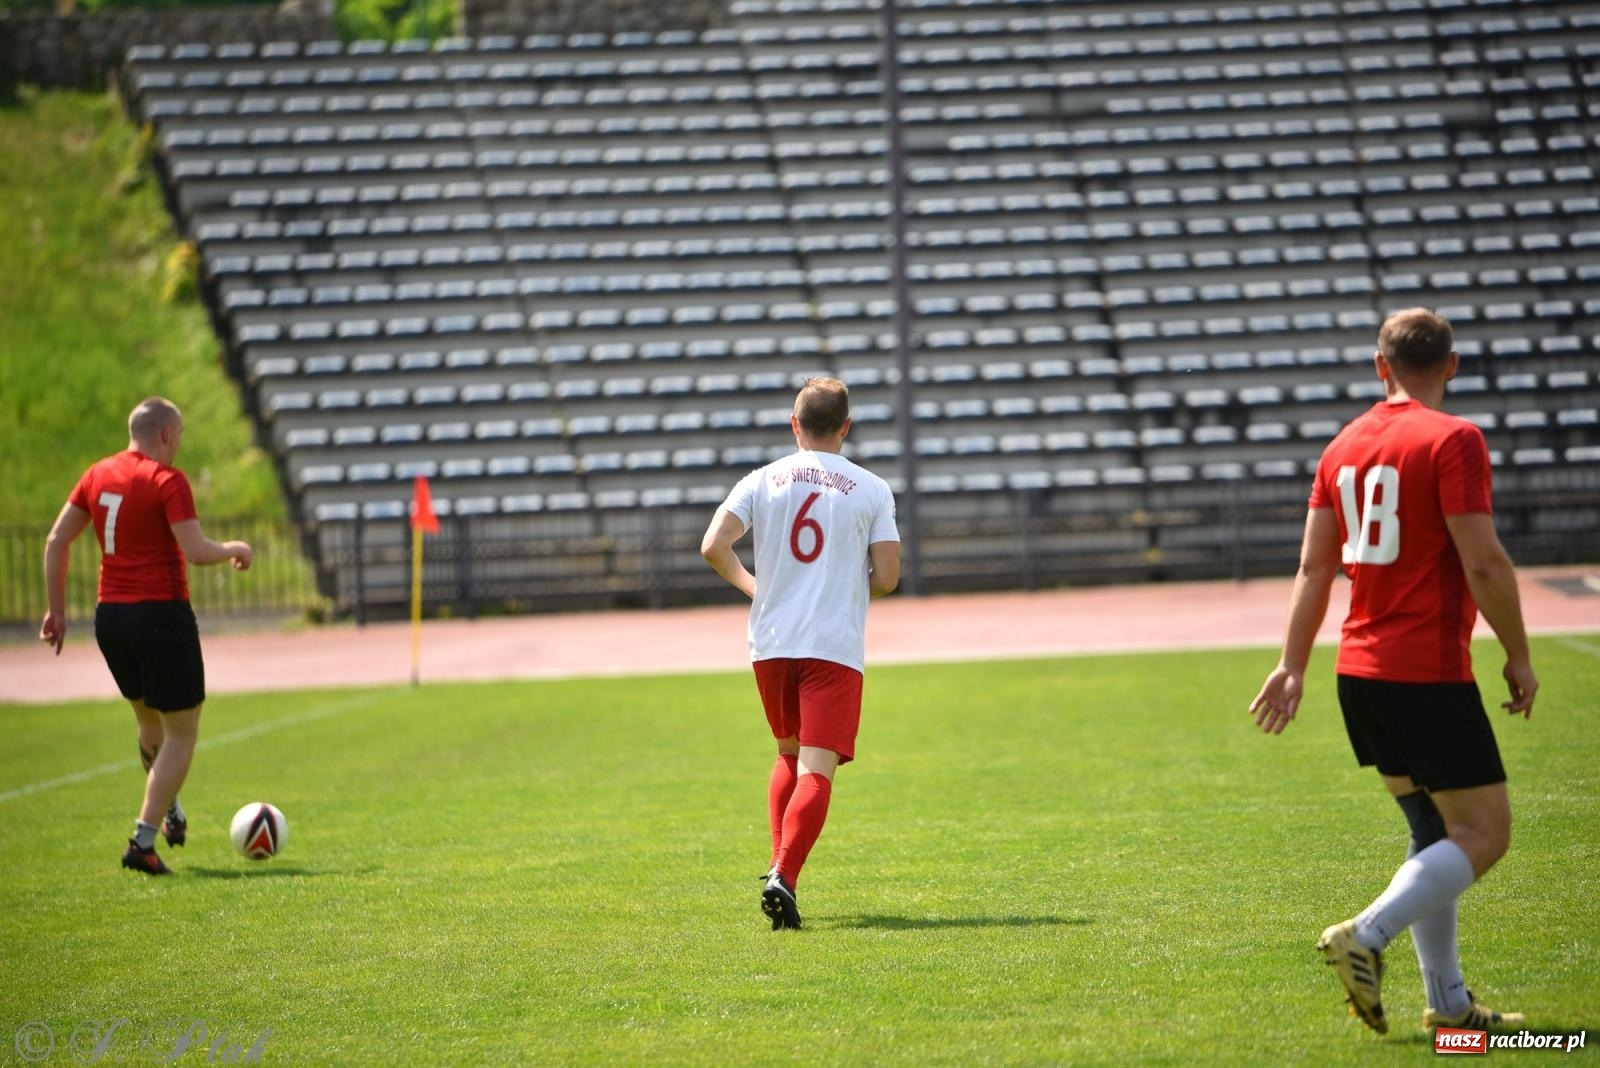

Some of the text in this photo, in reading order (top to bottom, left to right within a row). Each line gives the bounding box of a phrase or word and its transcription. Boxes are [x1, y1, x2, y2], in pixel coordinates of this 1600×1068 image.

[99, 491, 123, 555] 7
[791, 492, 824, 564] 6
[1336, 465, 1400, 566] 18
